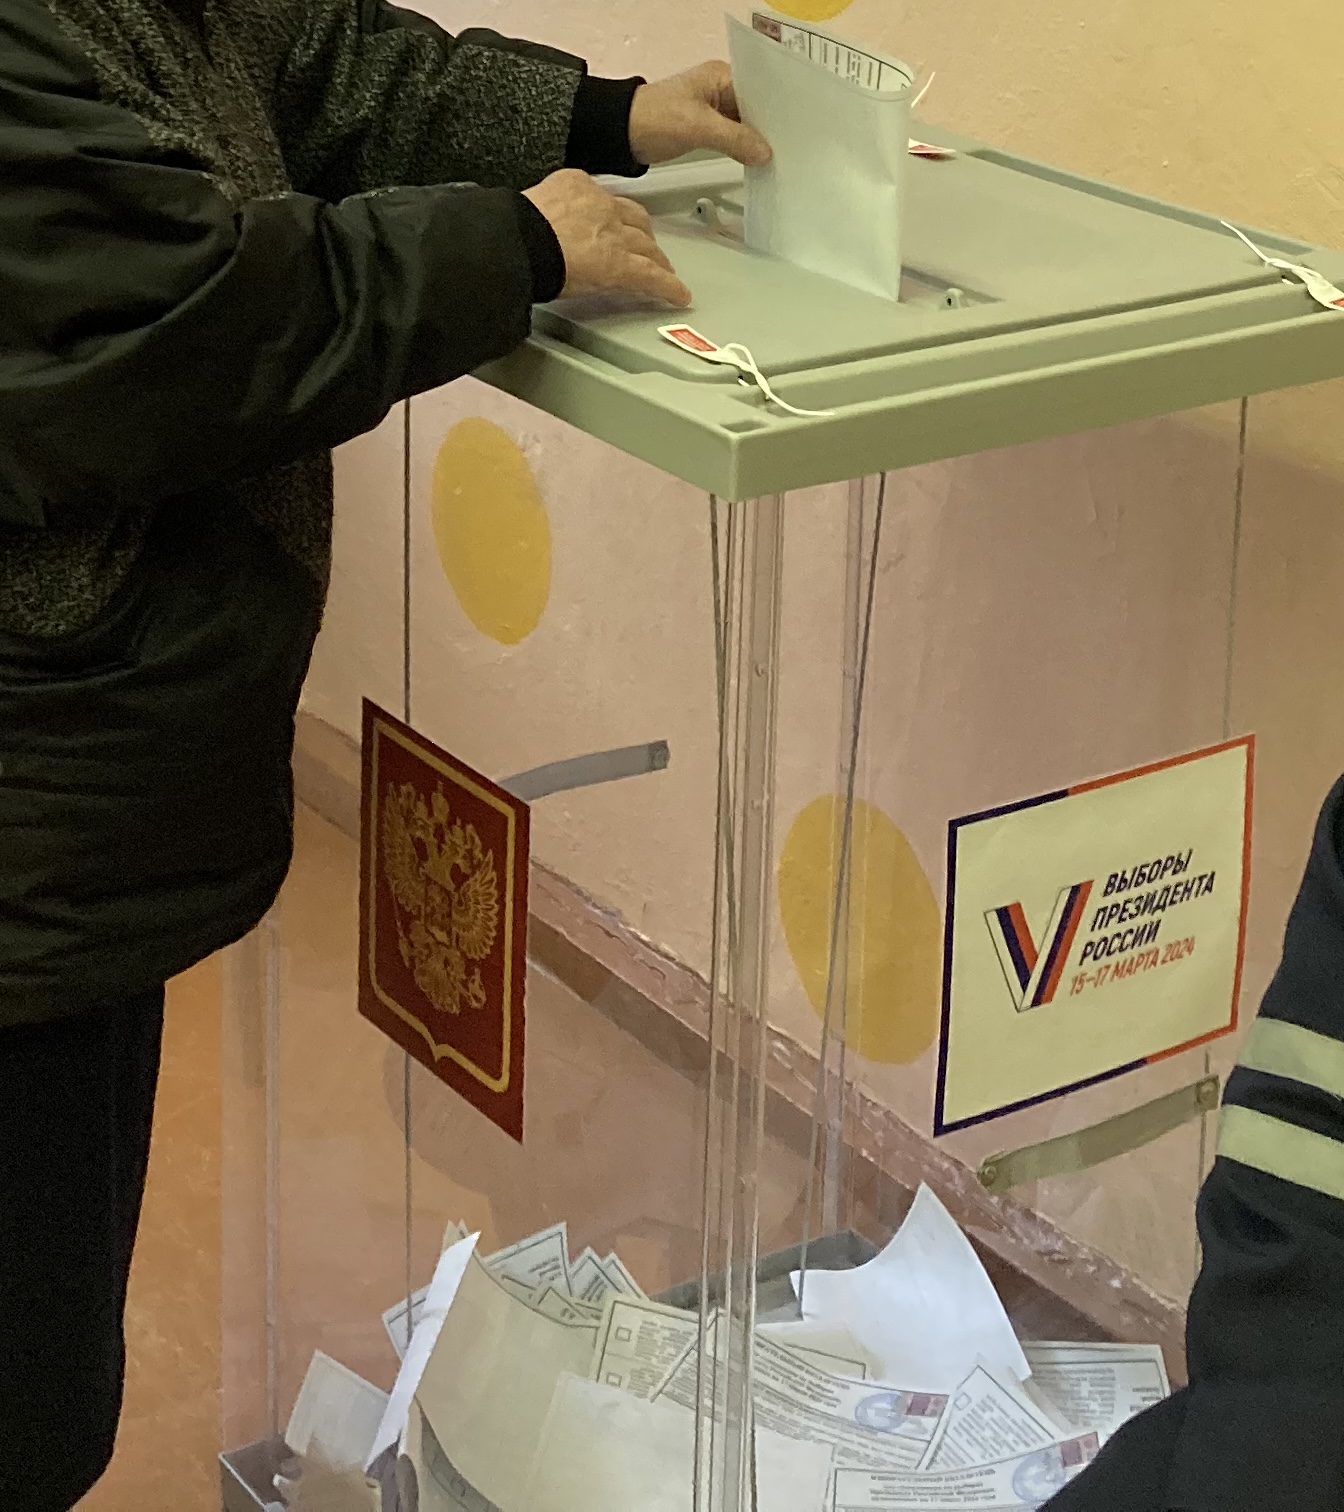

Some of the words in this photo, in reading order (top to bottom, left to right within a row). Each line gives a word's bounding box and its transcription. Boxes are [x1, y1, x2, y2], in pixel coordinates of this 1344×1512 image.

[1103, 848, 1193, 897] ВЫБОРЫ
[1090, 870, 1216, 932] ПРЕЗИДЕНТА
[1079, 918, 1162, 966] РОССИИ
[1110, 947, 1160, 982] МАРТА
[1161, 936, 1196, 965] 2024
